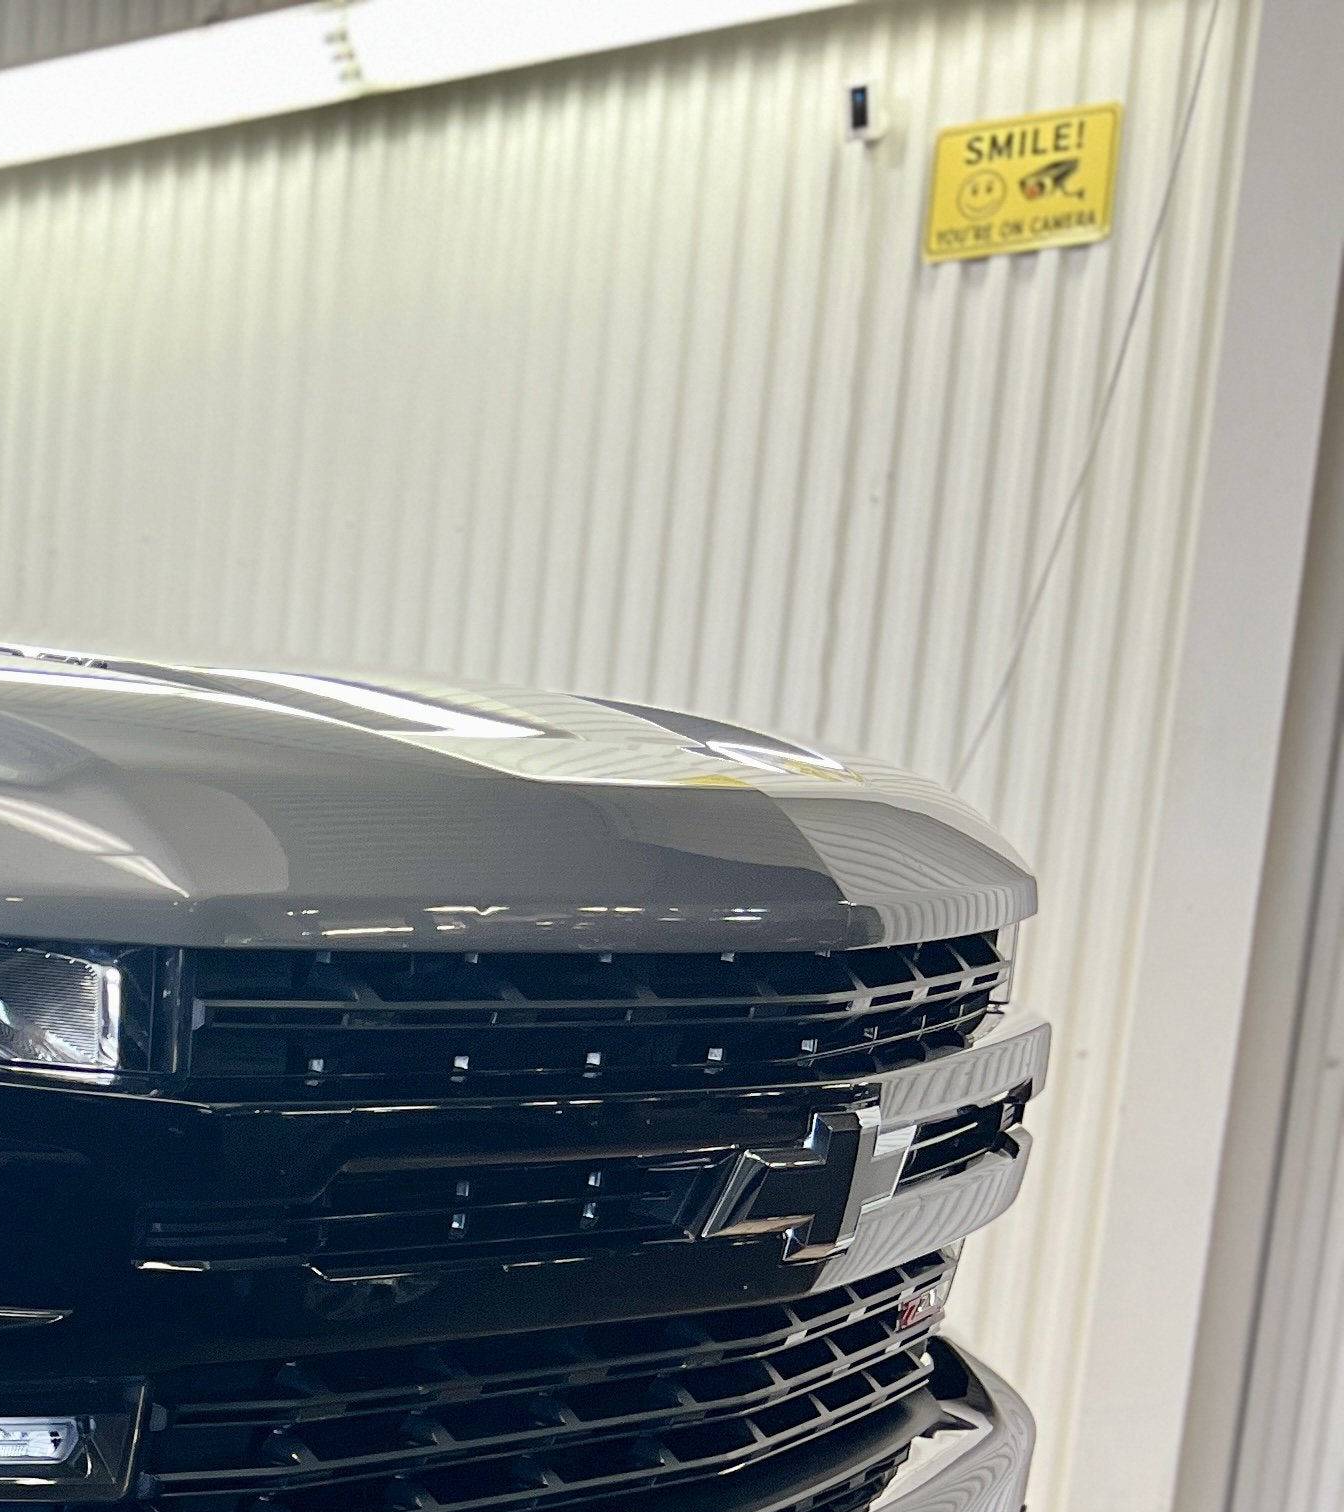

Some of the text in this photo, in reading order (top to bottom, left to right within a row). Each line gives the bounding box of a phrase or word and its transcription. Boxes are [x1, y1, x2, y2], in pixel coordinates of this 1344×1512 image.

[964, 121, 1086, 165] SMILE!
[936, 210, 1097, 245] YOU'RE ON CAMERA
